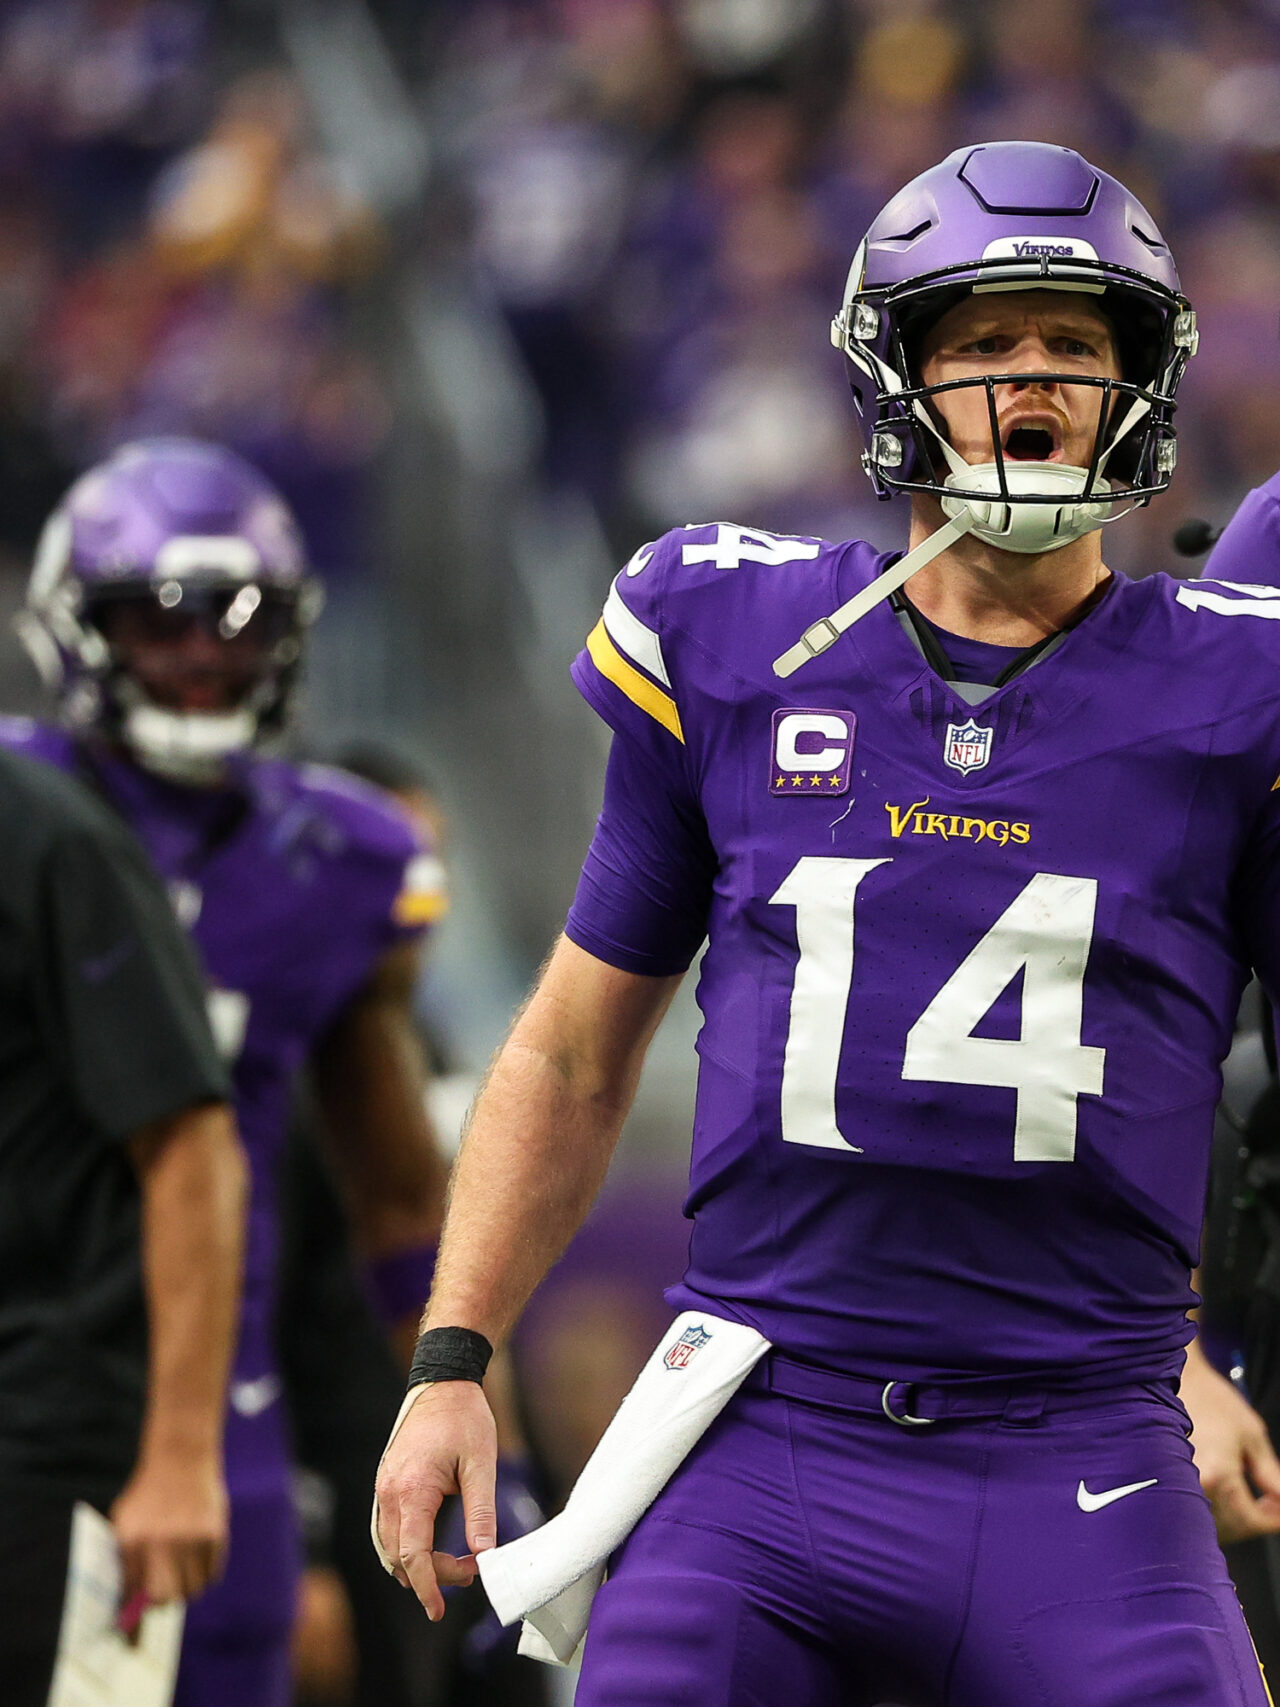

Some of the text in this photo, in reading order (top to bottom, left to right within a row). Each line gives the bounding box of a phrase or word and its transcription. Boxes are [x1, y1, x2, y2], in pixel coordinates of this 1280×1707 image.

[682, 522, 823, 569] 4
[776, 713, 849, 772] C
[952, 744, 982, 764] NFL
[885, 795, 1031, 847] VIKINGS
[767, 856, 1106, 1162] 14
[666, 1342, 695, 1367] NFL
